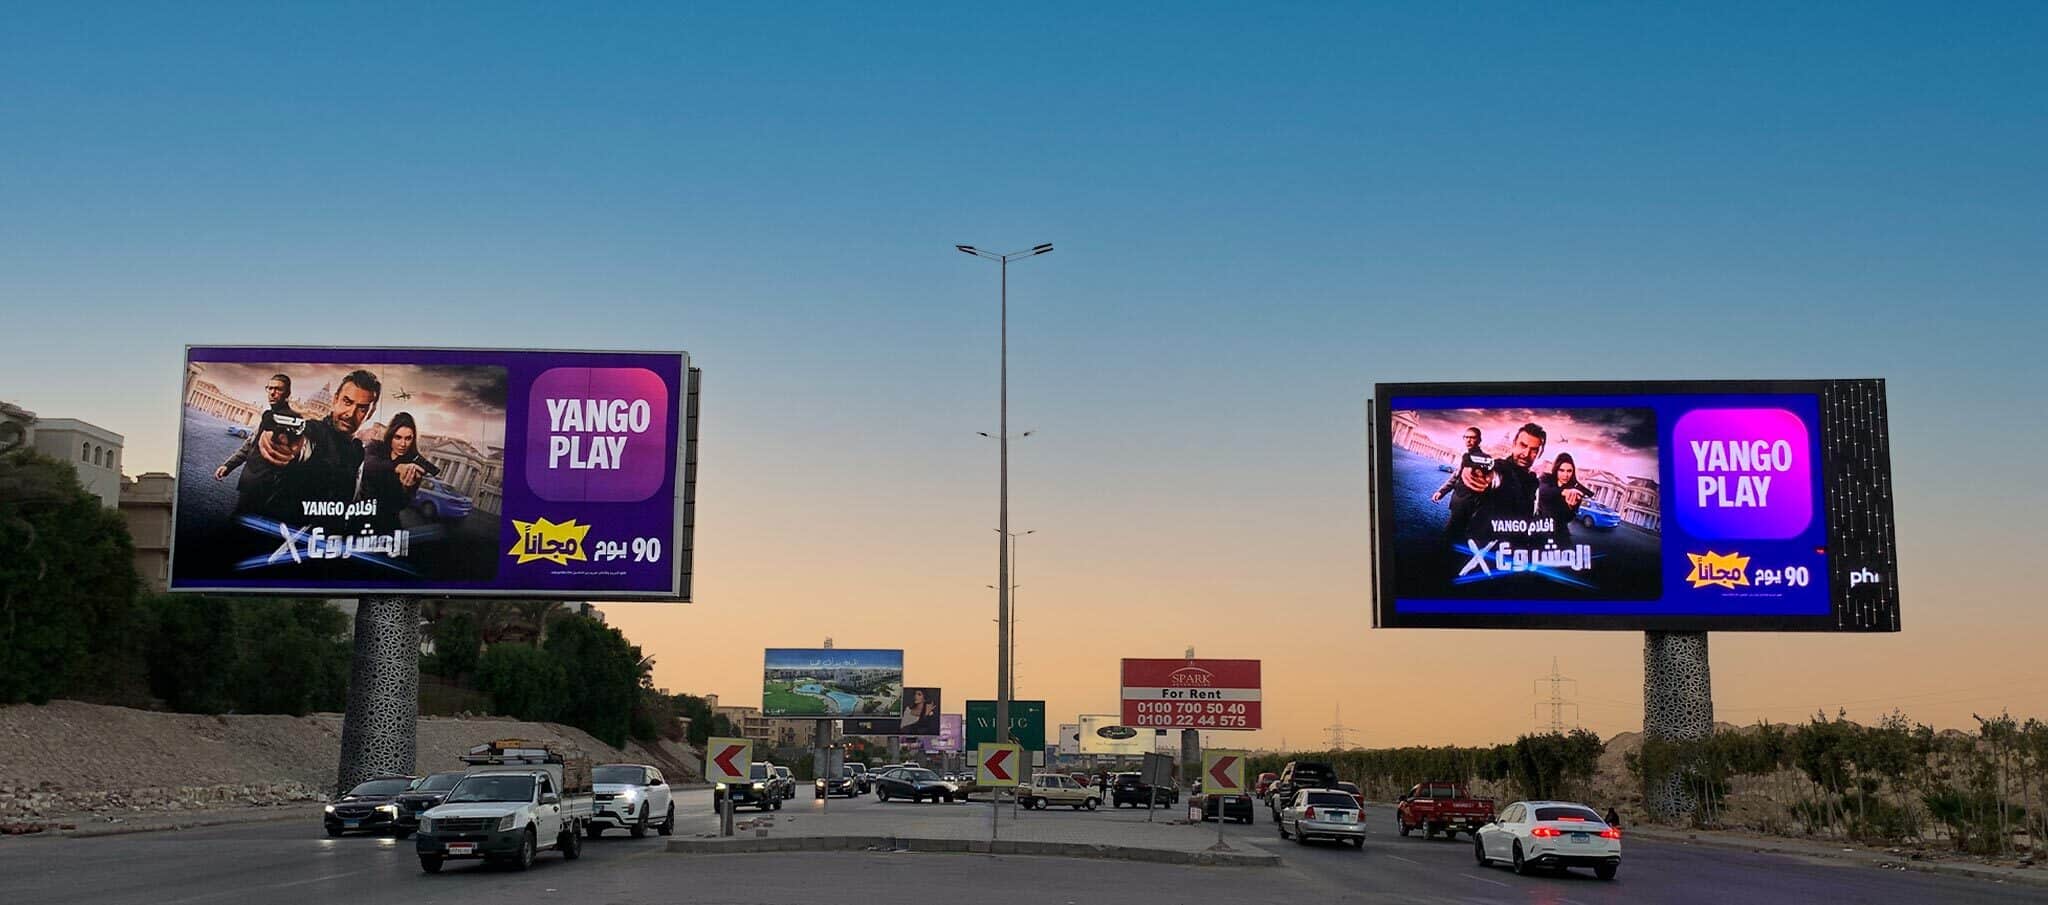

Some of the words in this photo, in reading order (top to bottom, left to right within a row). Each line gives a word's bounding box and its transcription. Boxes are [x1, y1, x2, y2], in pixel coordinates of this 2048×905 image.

[546, 399, 651, 433] YANGO
[548, 436, 628, 469] PLAY
[1690, 439, 1793, 472] YANGO
[1697, 475, 1772, 508] PLAY
[301, 500, 345, 516] YANGO
[344, 499, 378, 520] أفلام
[1491, 519, 1527, 532] YANGO
[267, 522, 312, 564] X
[307, 523, 410, 560] المشروع
[594, 541, 628, 562] يوم
[631, 537, 661, 562] 90
[1458, 538, 1498, 577] X
[1495, 539, 1592, 572] المشروع
[1755, 568, 1782, 587] يوم
[1784, 565, 1809, 587] 90
[1171, 673, 1211, 684] SPARK
[1161, 688, 1184, 699] For
[1189, 689, 1222, 700] Rent
[1137, 702, 1172, 713] 0100
[1175, 702, 1202, 714] 700
[1206, 703, 1224, 714] 50
[1227, 703, 1246, 715] 40
[1137, 714, 1172, 726] 0100
[1175, 715, 1194, 726] 22
[1197, 715, 1216, 726] 44
[1220, 715, 1246, 727] 575
